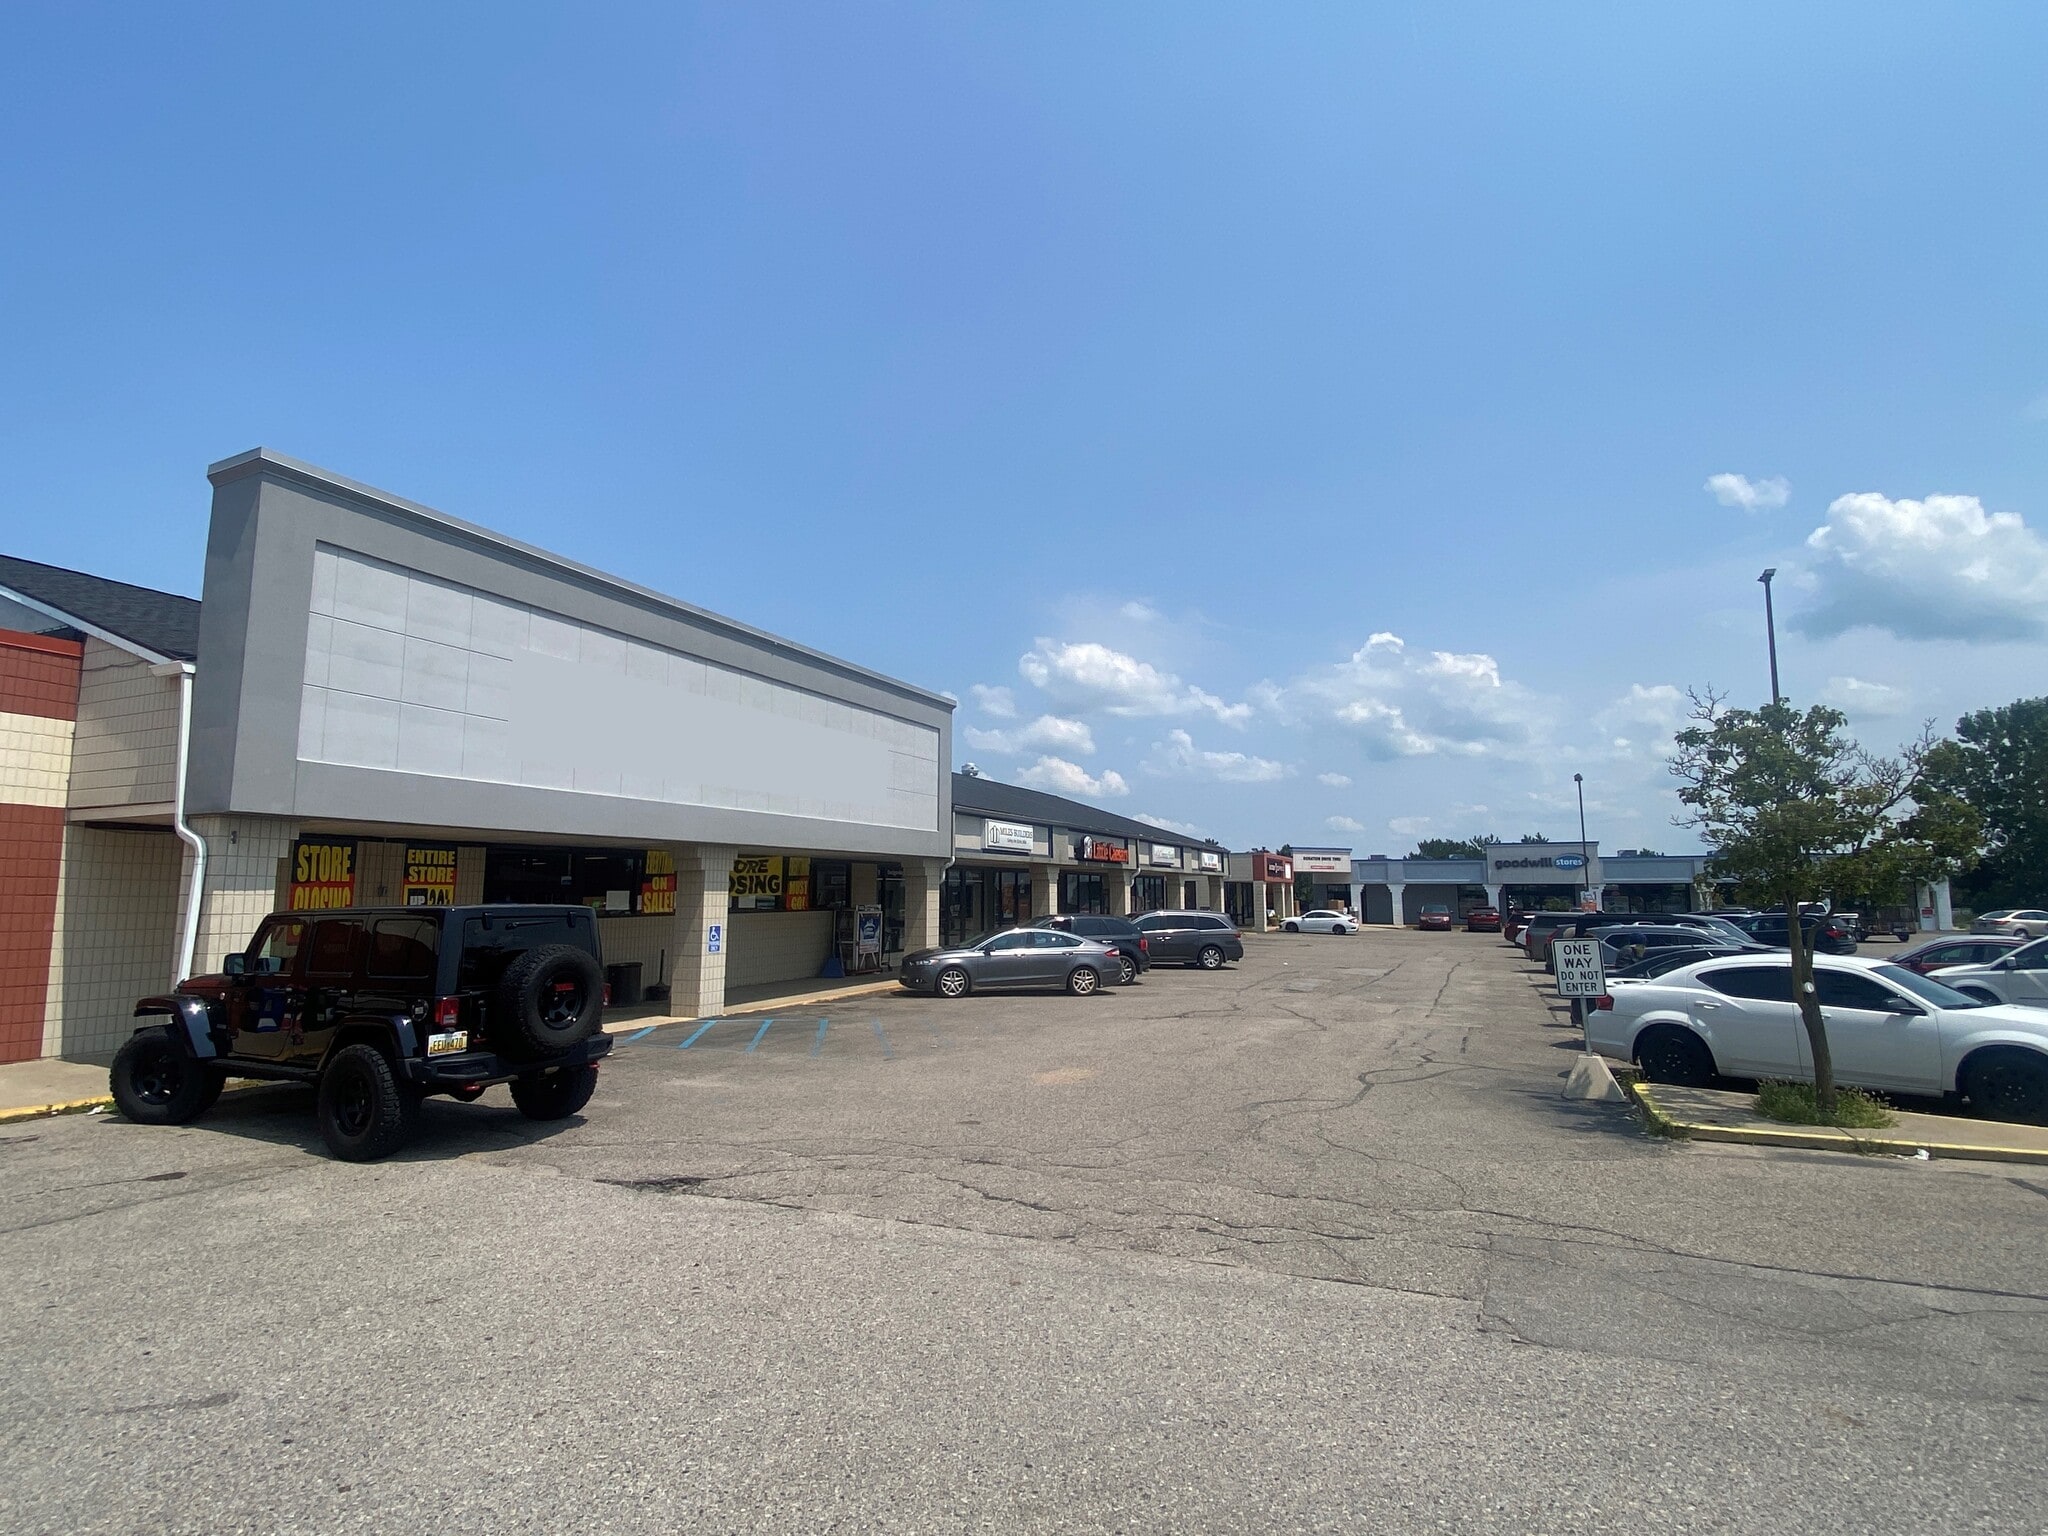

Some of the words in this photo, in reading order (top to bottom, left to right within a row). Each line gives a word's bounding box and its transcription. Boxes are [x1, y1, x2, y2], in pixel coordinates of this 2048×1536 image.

[1014, 829, 1033, 839] BUILDERS
[407, 849, 456, 865] ENTIRE
[1093, 841, 1109, 860] Little
[297, 844, 352, 882] STORE
[734, 859, 769, 874] ORE
[1495, 857, 1553, 870] goodwill
[408, 866, 454, 882] STORE
[652, 876, 668, 890] ON
[729, 874, 780, 895] OSING
[789, 879, 808, 895] MUST
[643, 891, 674, 913] SALE!
[791, 896, 806, 910] GO!
[1563, 944, 1591, 955] ONE
[1564, 957, 1593, 968] WAY
[1560, 971, 1575, 980] DO
[1579, 971, 1600, 980] NOT
[1565, 982, 1598, 992] ENTER
